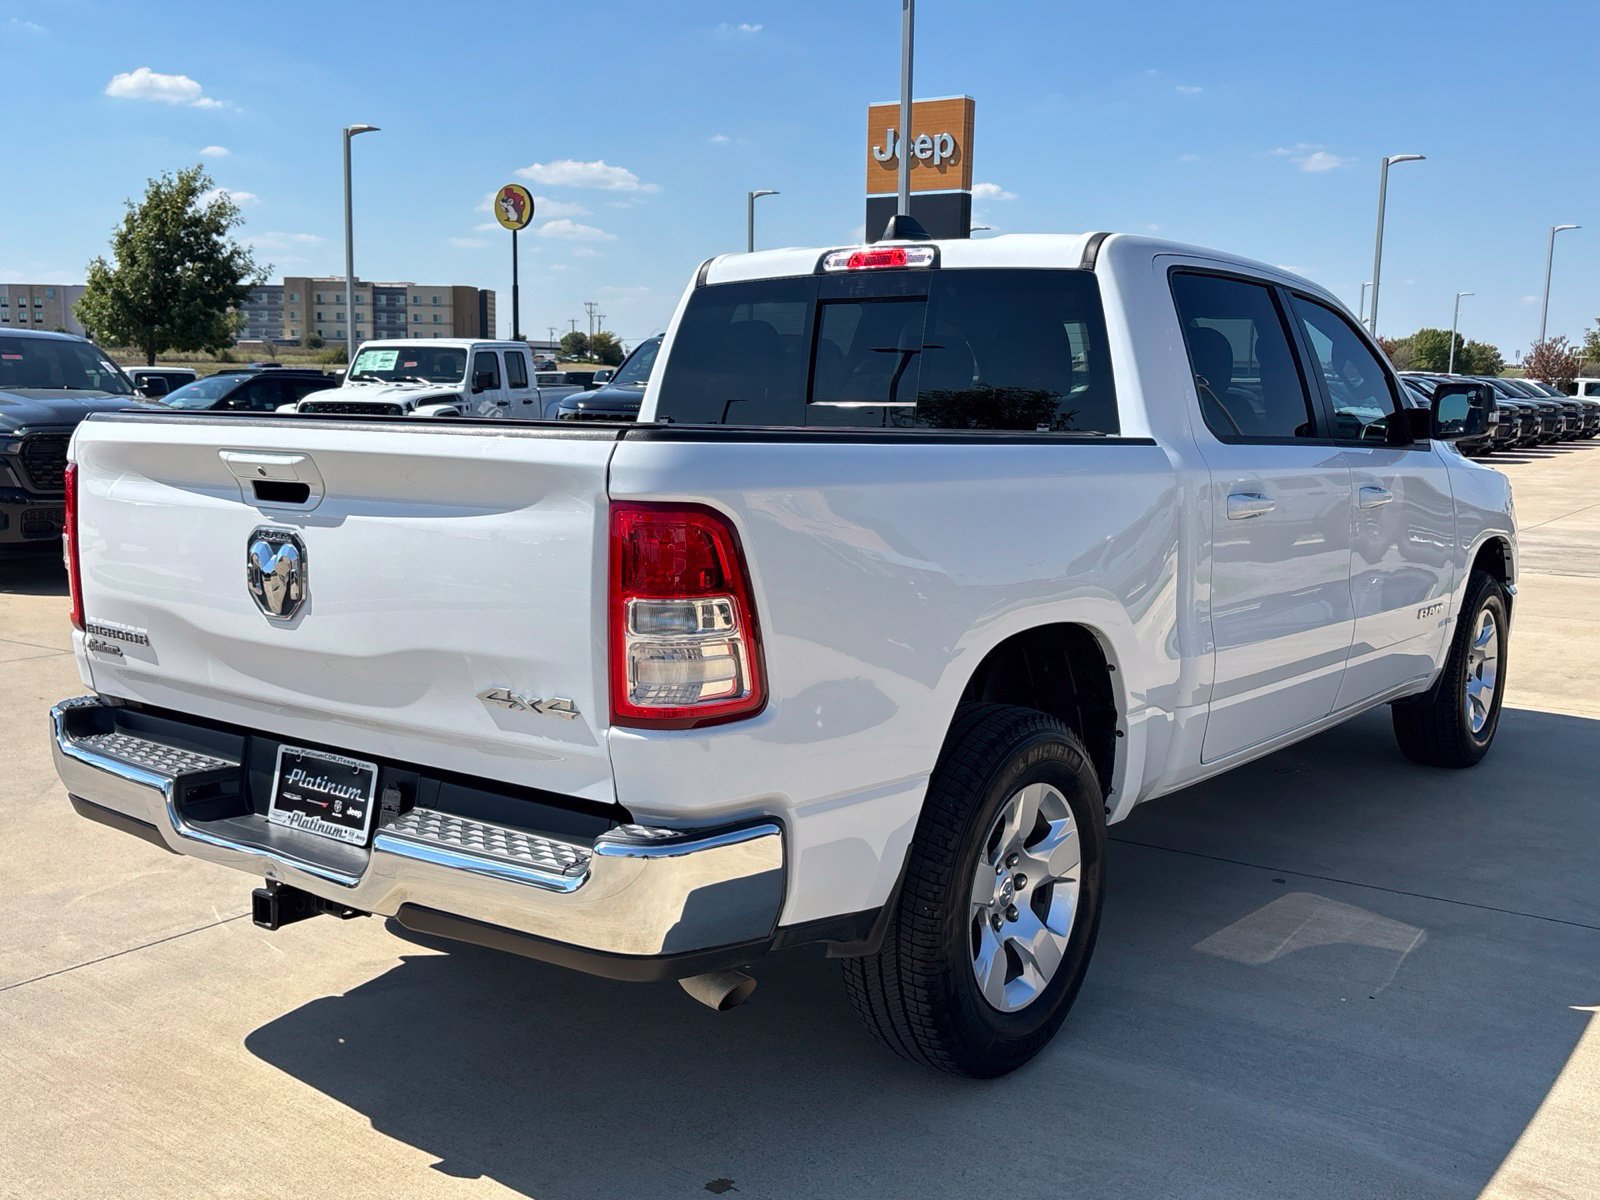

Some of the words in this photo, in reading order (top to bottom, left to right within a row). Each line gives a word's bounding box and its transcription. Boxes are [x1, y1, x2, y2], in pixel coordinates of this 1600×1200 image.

[1417, 602, 1444, 619] RAM
[1027, 743, 1081, 768] MICHELIN
[285, 768, 365, 802] Platinum
[346, 806, 363, 819] Jeep
[289, 812, 347, 839] Platinum
